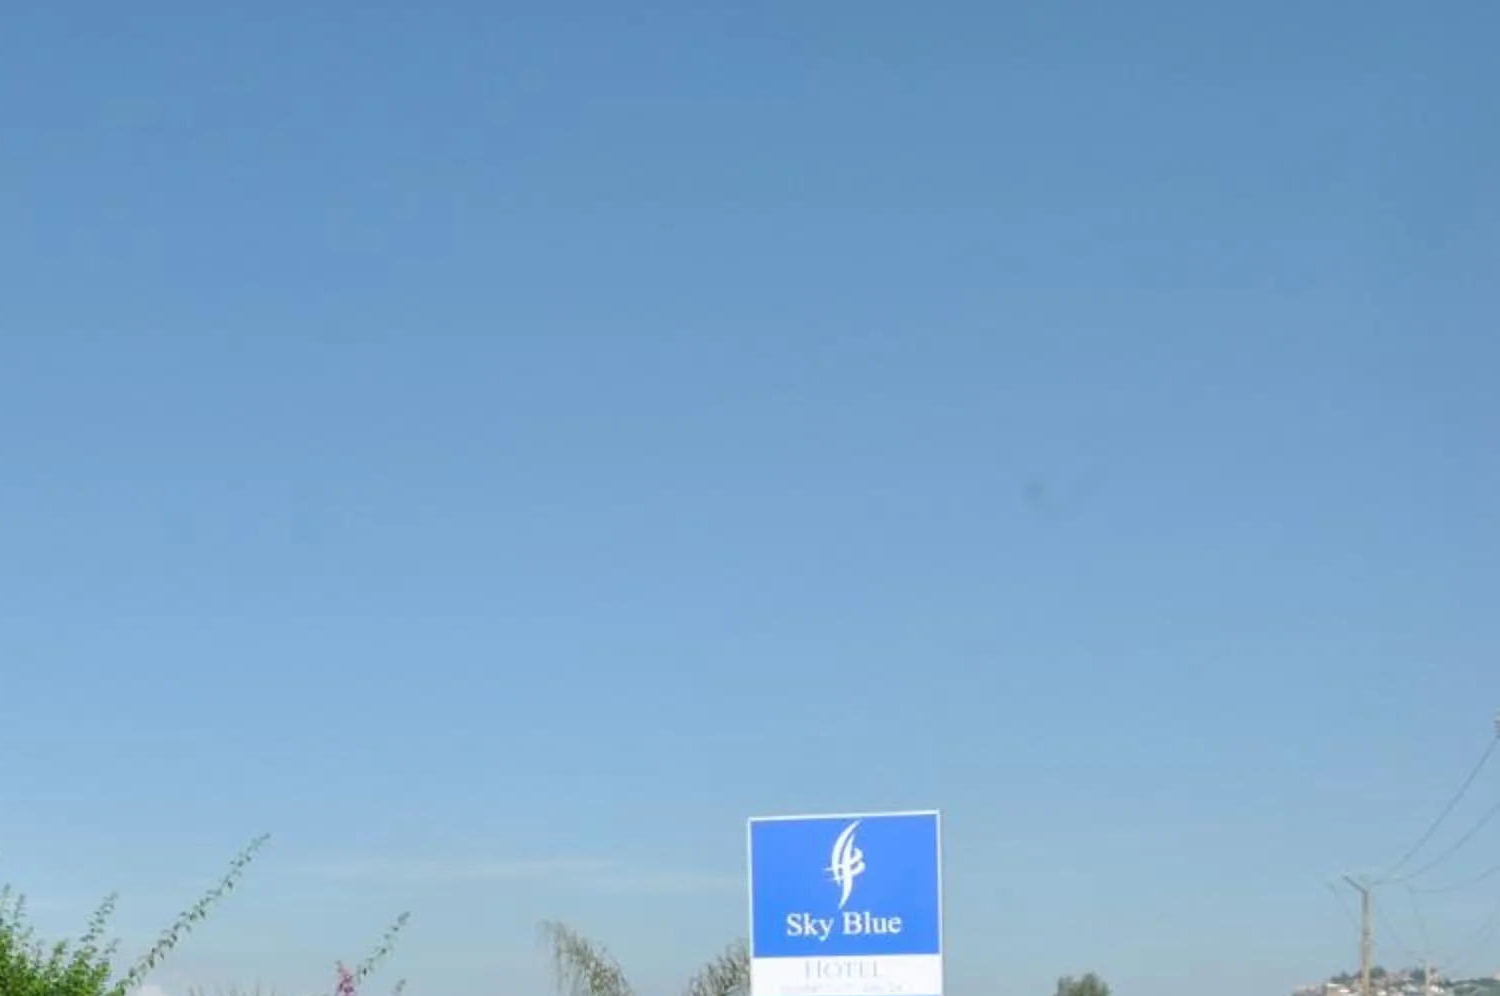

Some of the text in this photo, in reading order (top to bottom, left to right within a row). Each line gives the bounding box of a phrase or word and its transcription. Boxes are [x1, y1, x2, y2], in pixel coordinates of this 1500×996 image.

[786, 910, 902, 942] Sky Blue
[805, 960, 881, 979] HOTEL
